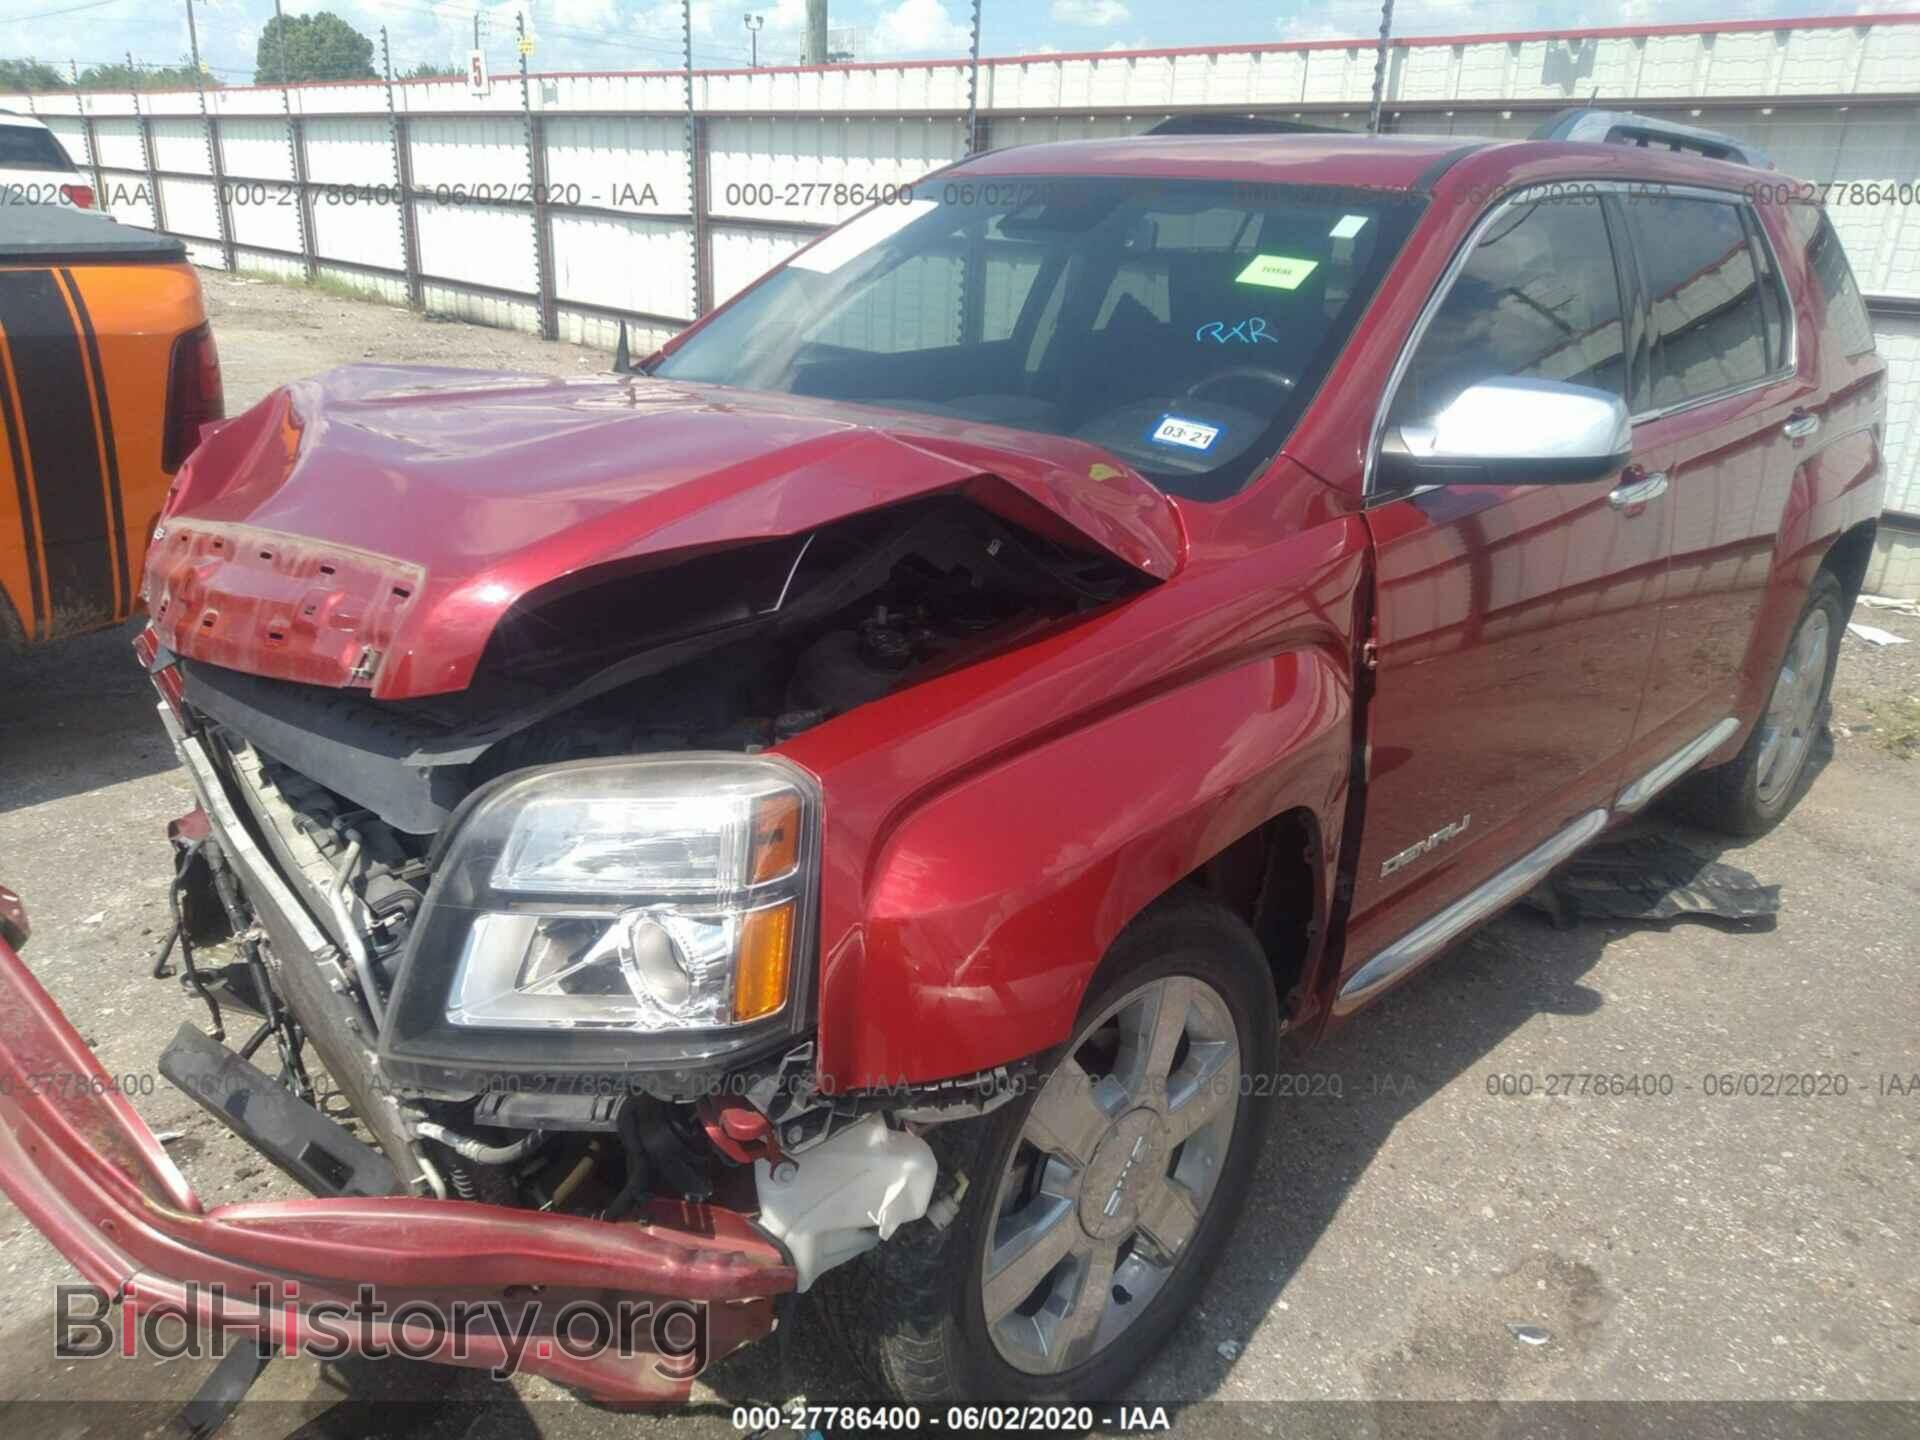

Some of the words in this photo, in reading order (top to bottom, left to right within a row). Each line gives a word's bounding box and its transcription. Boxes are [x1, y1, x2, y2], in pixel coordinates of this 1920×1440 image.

[471, 57, 482, 87] 5
[1162, 425, 1184, 438] 03
[1188, 431, 1211, 444] 21
